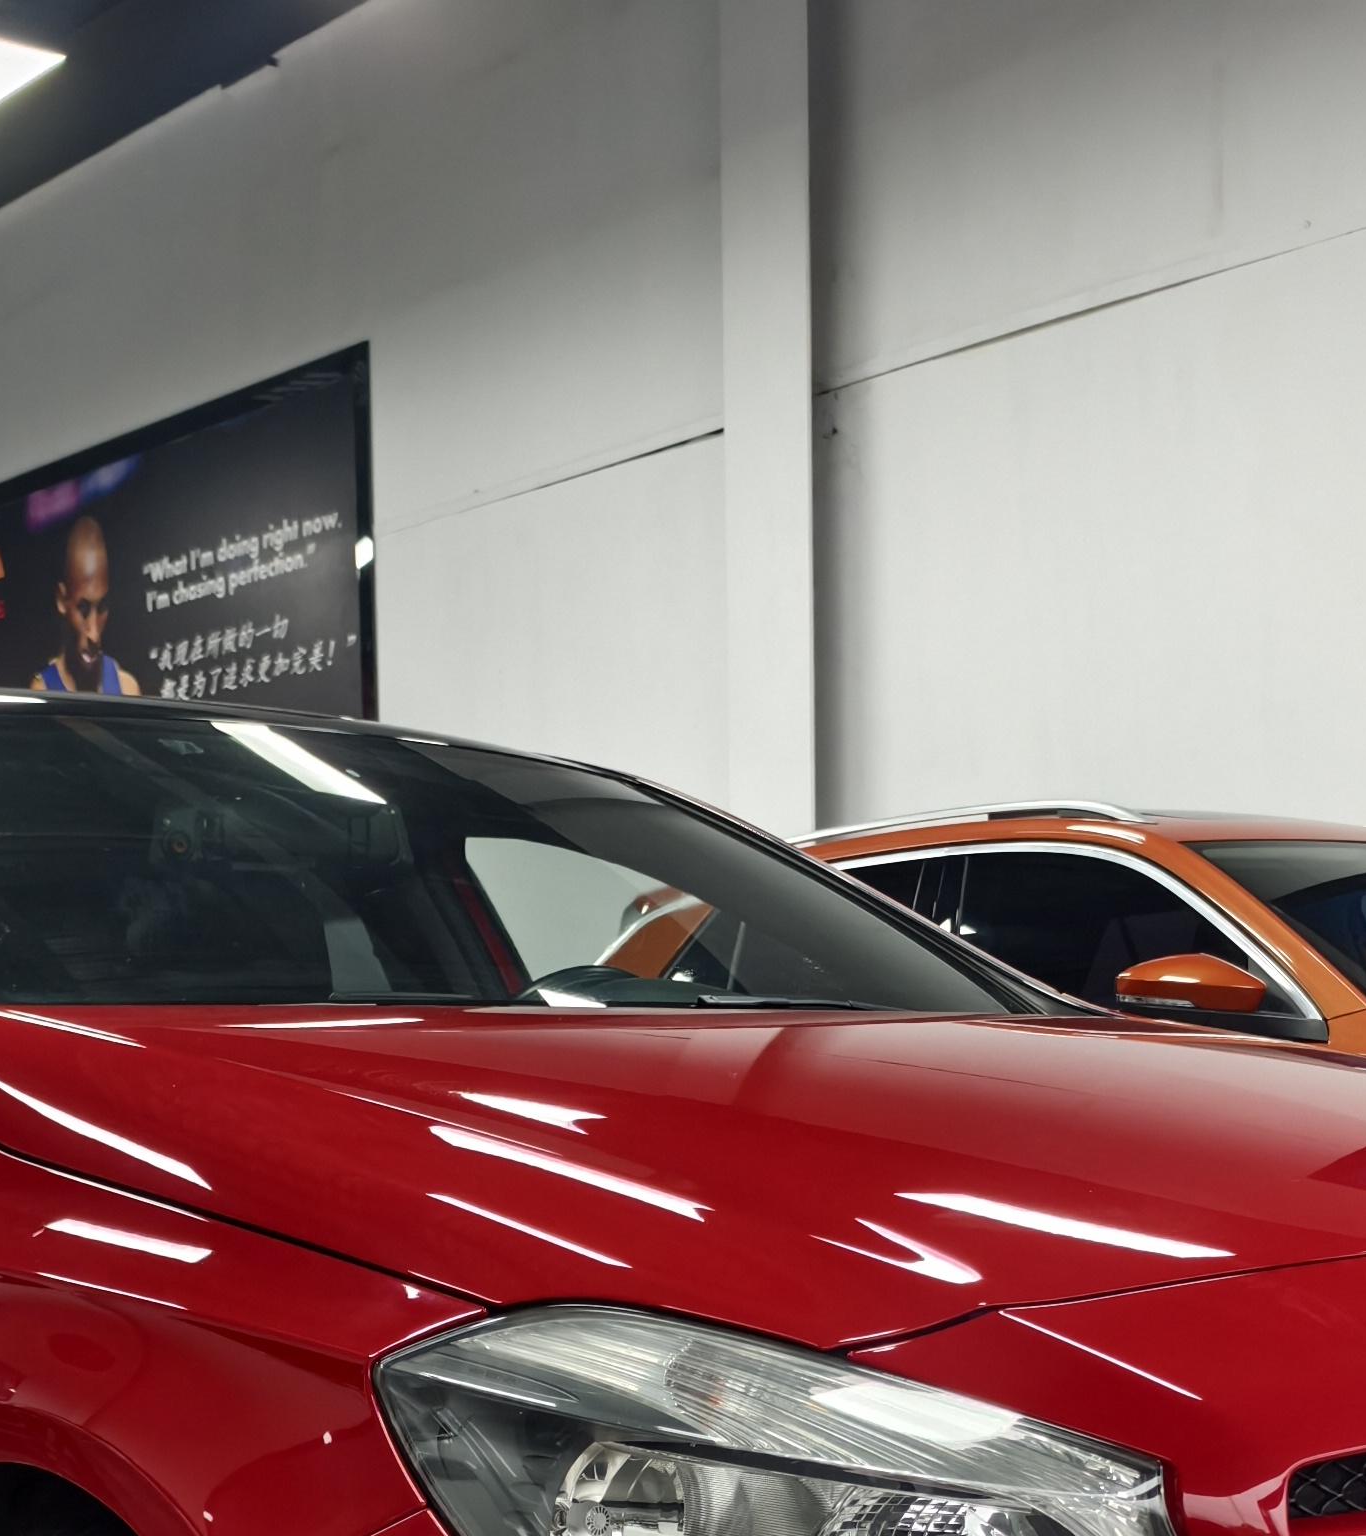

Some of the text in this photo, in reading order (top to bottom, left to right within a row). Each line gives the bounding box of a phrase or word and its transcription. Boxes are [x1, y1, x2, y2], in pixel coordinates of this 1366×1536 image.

[216, 534, 260, 563] doing
[262, 518, 299, 551] right
[172, 573, 226, 607] chasing
